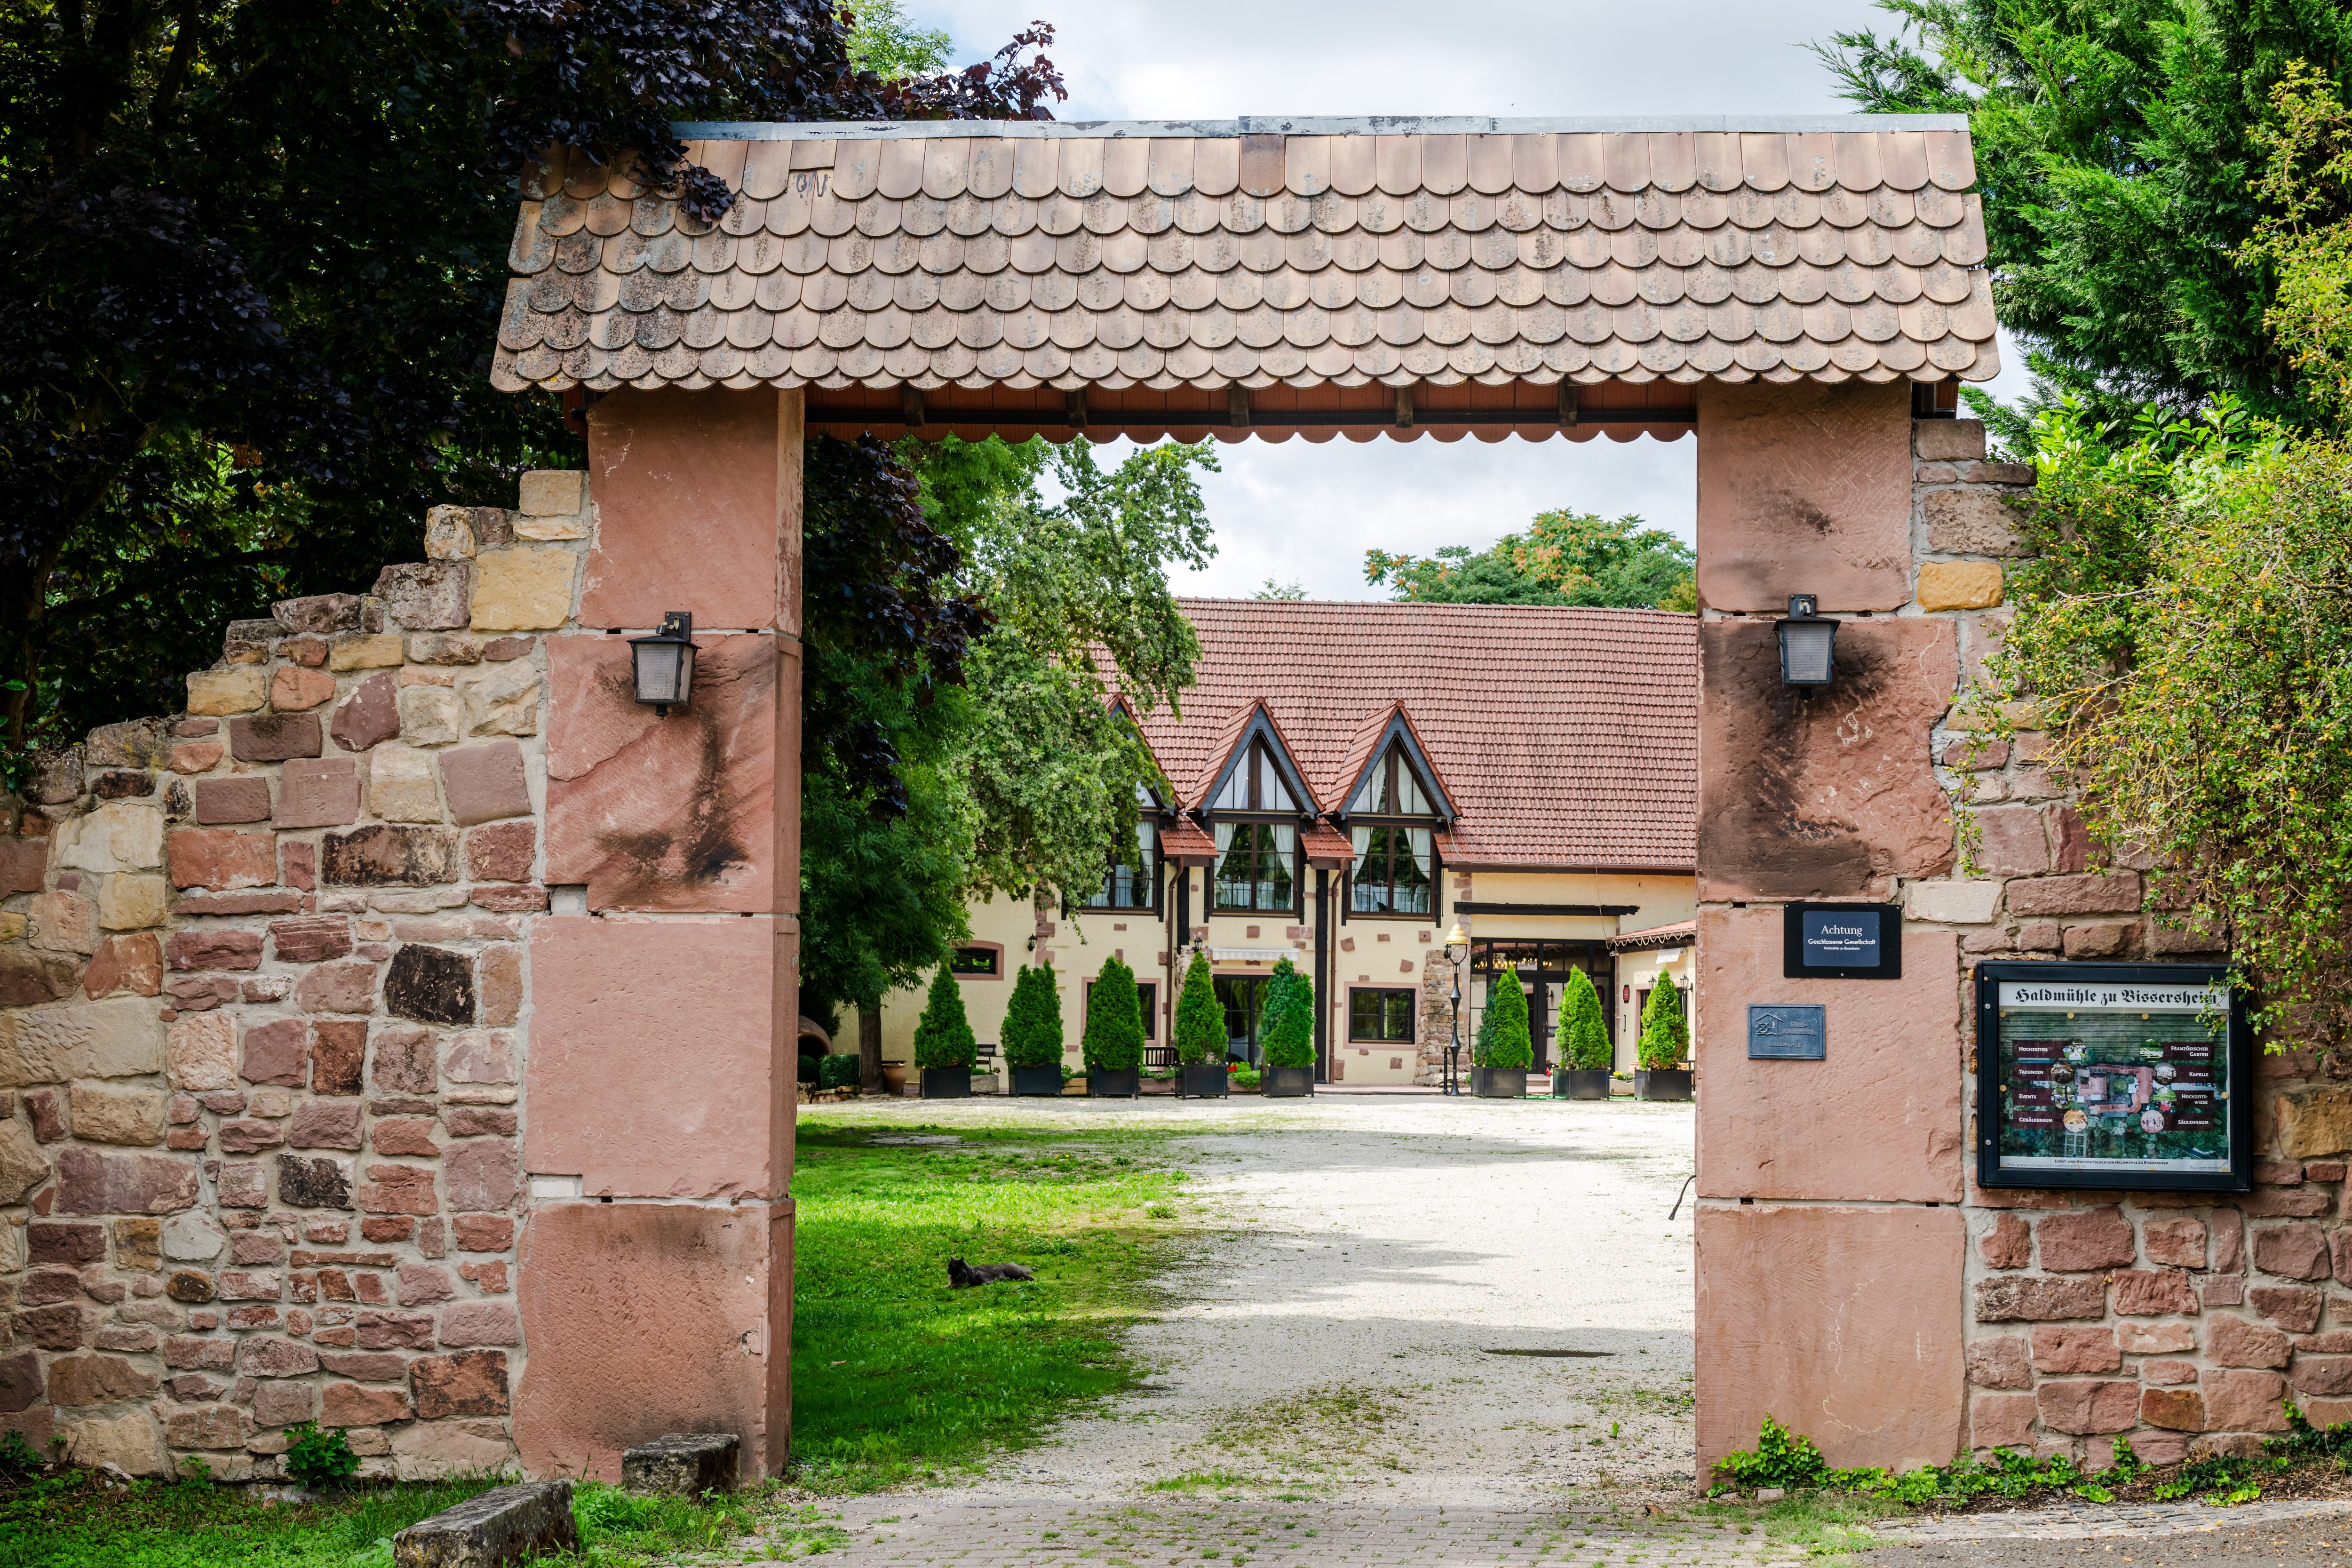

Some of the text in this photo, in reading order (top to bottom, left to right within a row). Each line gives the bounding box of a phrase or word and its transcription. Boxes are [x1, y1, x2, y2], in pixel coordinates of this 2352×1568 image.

[1821, 925, 1862, 937] Achtung
[2016, 988, 2096, 1005] Haldmühle
[2101, 993, 2117, 1006] zu
